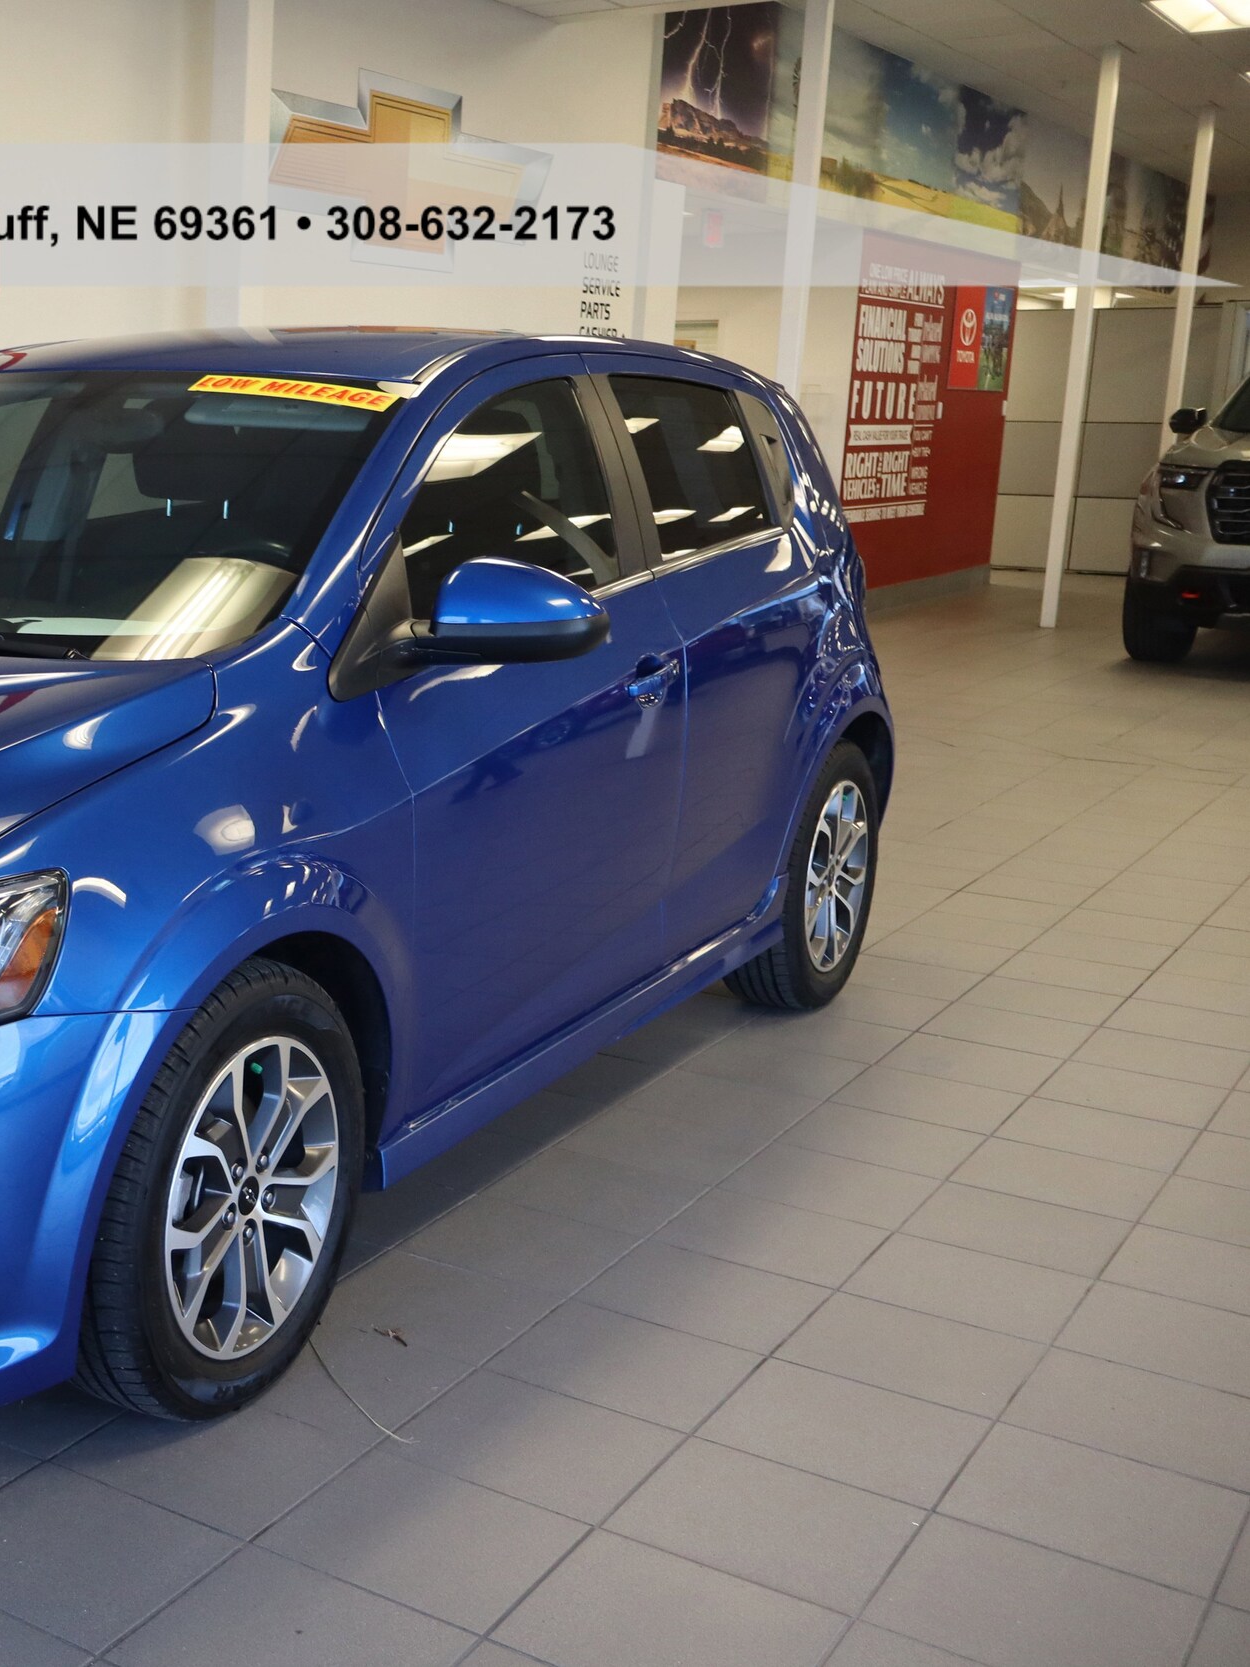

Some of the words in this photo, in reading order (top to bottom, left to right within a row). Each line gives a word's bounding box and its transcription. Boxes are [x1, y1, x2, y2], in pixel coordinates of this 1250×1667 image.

[583, 251, 619, 272] LOUNGE
[582, 276, 621, 298] SERVICE
[907, 268, 945, 305] ALWAYS
[580, 300, 611, 320] PARTS
[858, 304, 908, 342] FINANCIAL
[855, 338, 905, 375] SOLUTIONS
[198, 377, 260, 390] LOW
[260, 381, 392, 407] MILEAGE
[850, 380, 917, 420] FUTURE
[844, 453, 879, 479] RIGHT
[882, 451, 910, 473] RIGHT
[843, 478, 877, 500] VEHICLES
[881, 473, 908, 498] TIME
